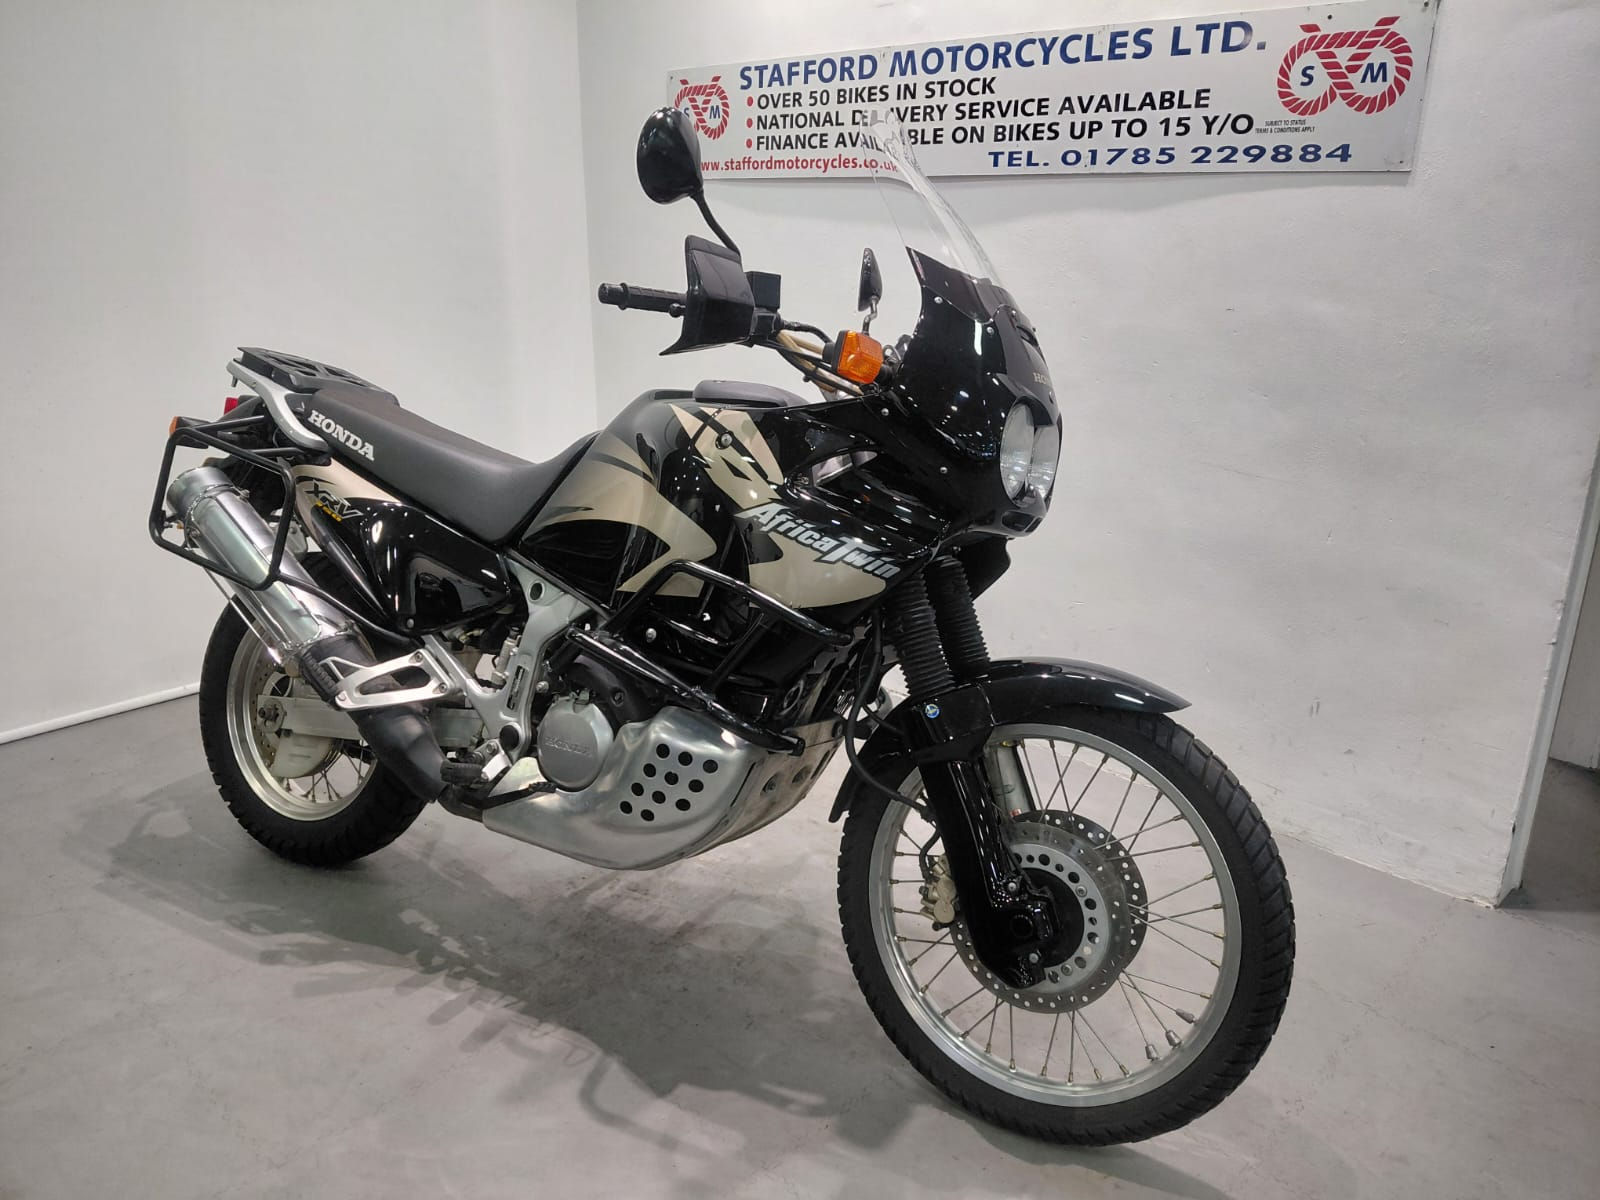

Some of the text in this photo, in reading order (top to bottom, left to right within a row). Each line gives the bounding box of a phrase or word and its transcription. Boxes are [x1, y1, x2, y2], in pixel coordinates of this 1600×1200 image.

[739, 20, 1267, 91] STAFFORD MOTORCYCLES LTD.
[757, 76, 997, 110] OVER 50 BIKES IN STOCK
[1300, 62, 1388, 87] S M
[709, 105, 721, 119] M
[756, 88, 1211, 130] NATIONAL DELVERY SERVICE AVAILABLE
[756, 113, 1254, 153] FINANCE AVAILBLE ON BIKES UP TO 15 Y/O
[701, 153, 898, 174] ww.staffordmotorcycles.co.uk
[988, 143, 1352, 168] TEL. 01785 229884
[307, 409, 375, 461] HONDA
[734, 502, 901, 579] Africa Twin
